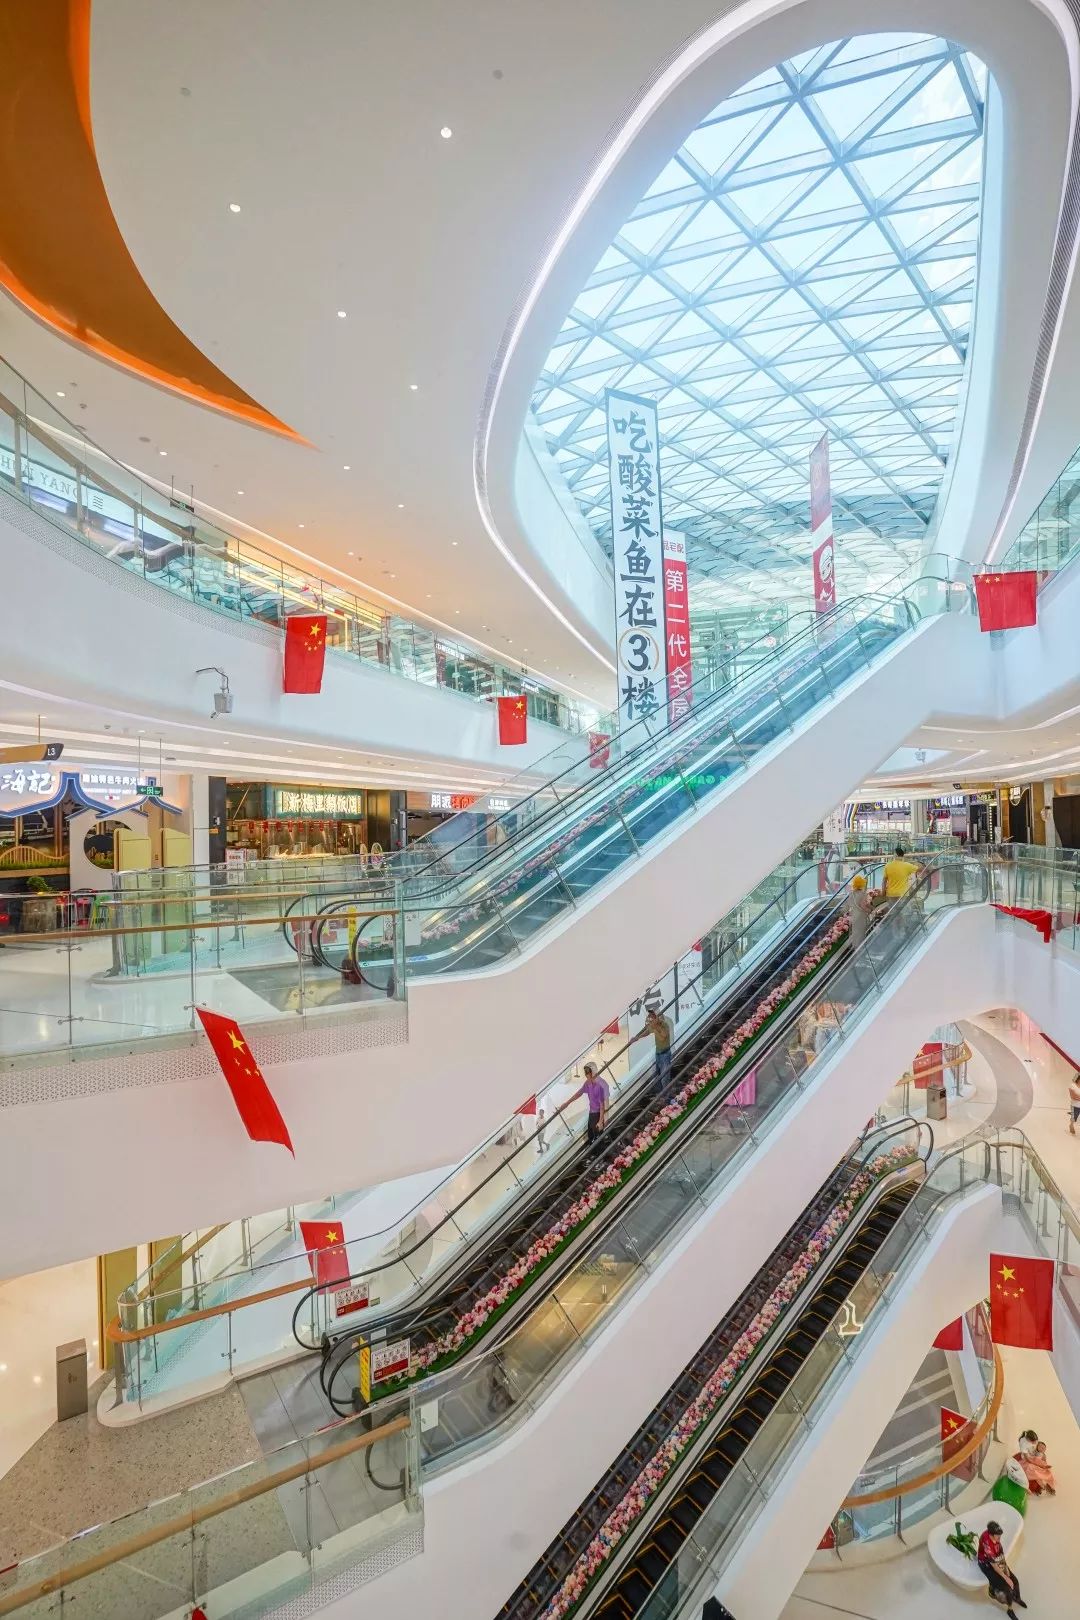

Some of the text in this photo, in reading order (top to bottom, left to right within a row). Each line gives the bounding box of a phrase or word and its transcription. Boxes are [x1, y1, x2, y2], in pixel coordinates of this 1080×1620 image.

[612, 410, 660, 722] 吃酸菜鱼在3楼
[47, 747, 56, 756] L3
